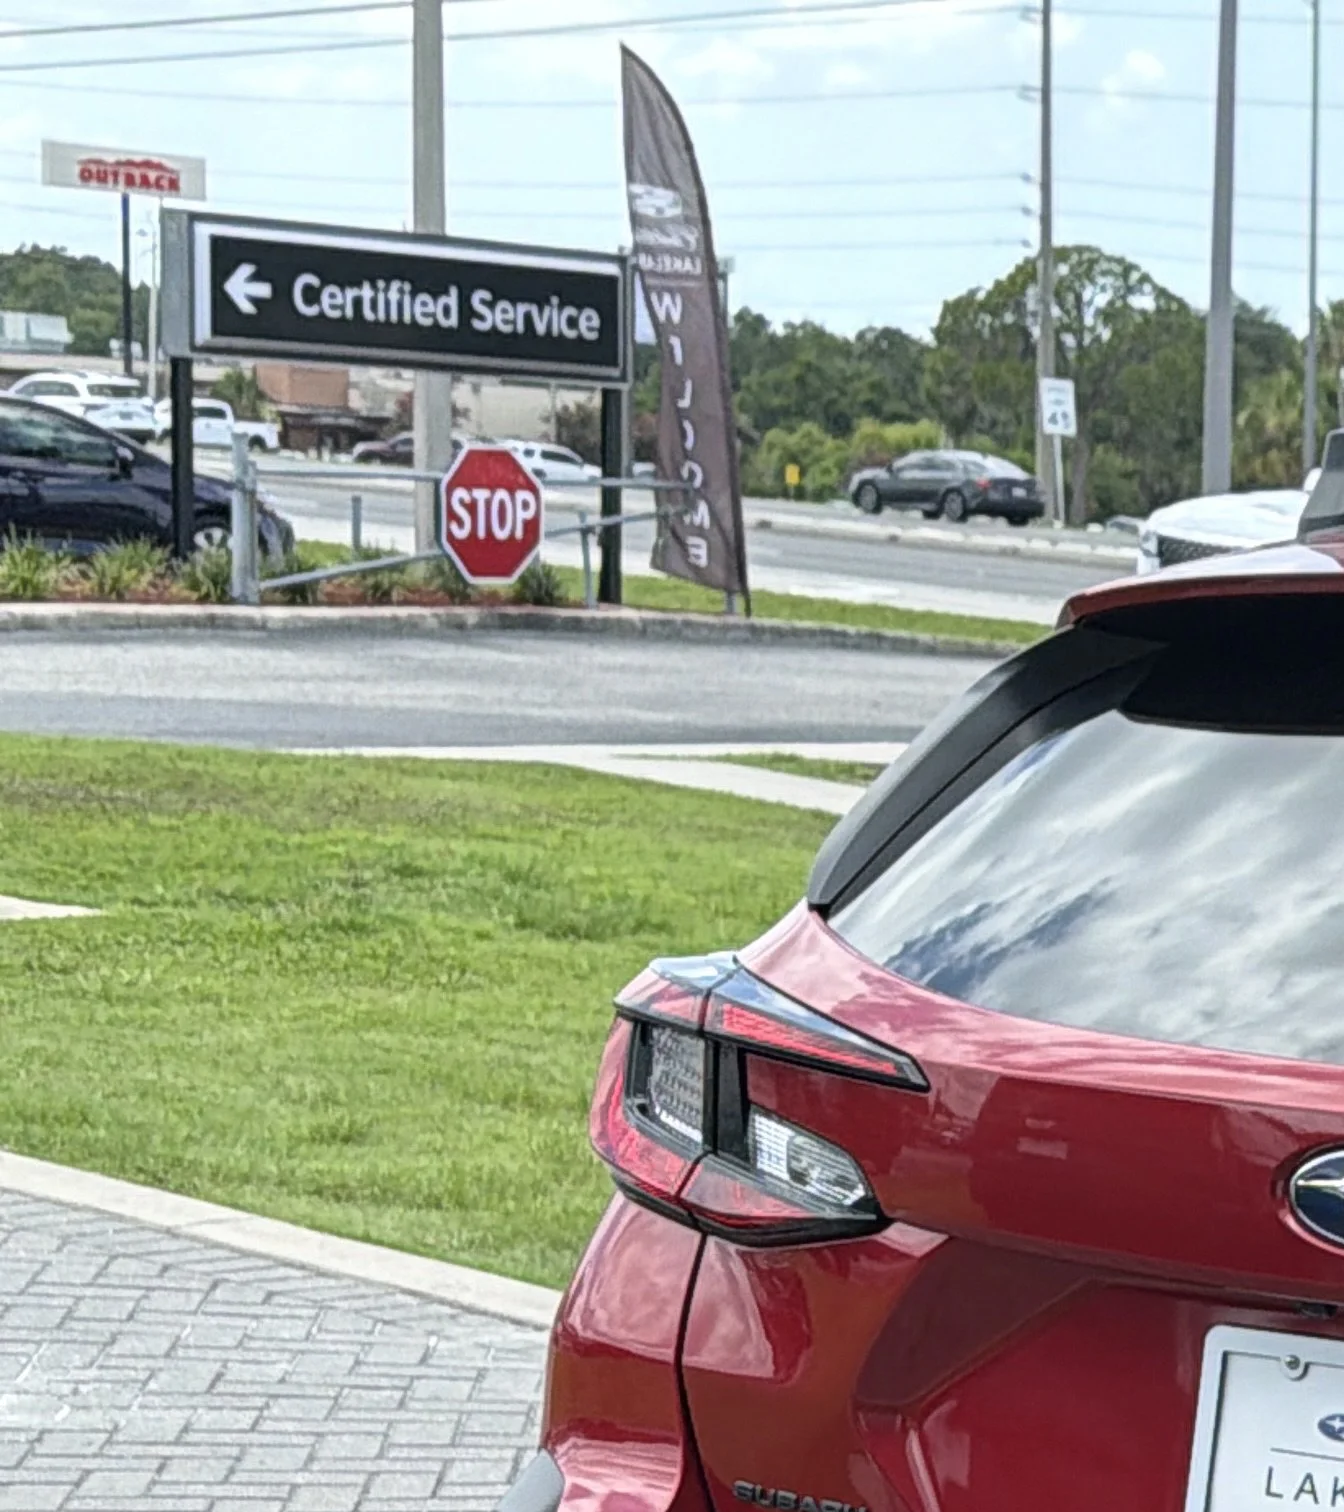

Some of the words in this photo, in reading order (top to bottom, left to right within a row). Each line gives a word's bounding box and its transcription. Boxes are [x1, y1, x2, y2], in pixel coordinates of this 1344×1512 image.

[79, 167, 181, 192] OUTBACK
[292, 273, 460, 329] Certified
[470, 288, 601, 341] Service
[449, 487, 538, 541] STOP
